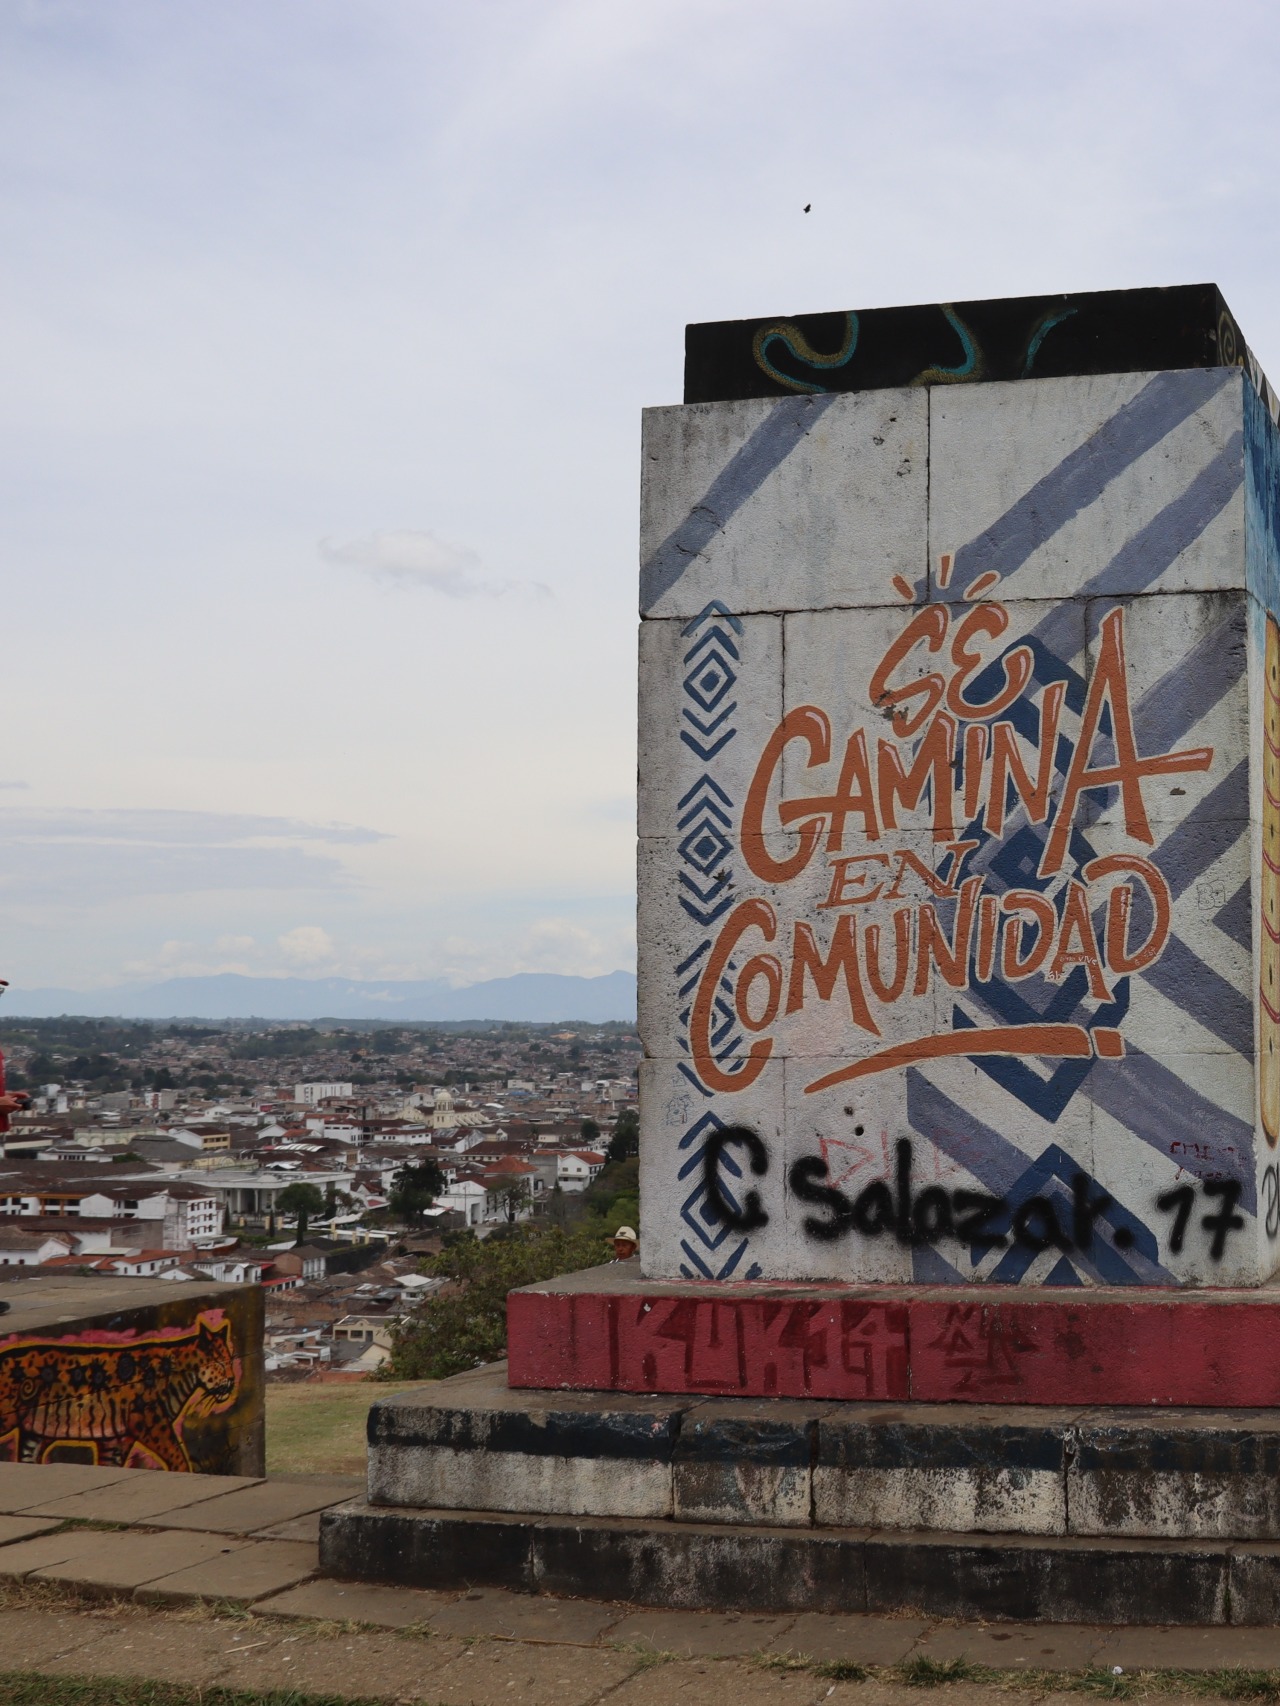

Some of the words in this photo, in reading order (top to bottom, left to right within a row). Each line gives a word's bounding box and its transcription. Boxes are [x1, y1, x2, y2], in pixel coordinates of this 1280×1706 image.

[741, 606, 1213, 883] CAMINA
[817, 841, 976, 909] EN
[690, 856, 1171, 1093] COMUNIDAD
[1156, 1178, 1244, 1262] 17
